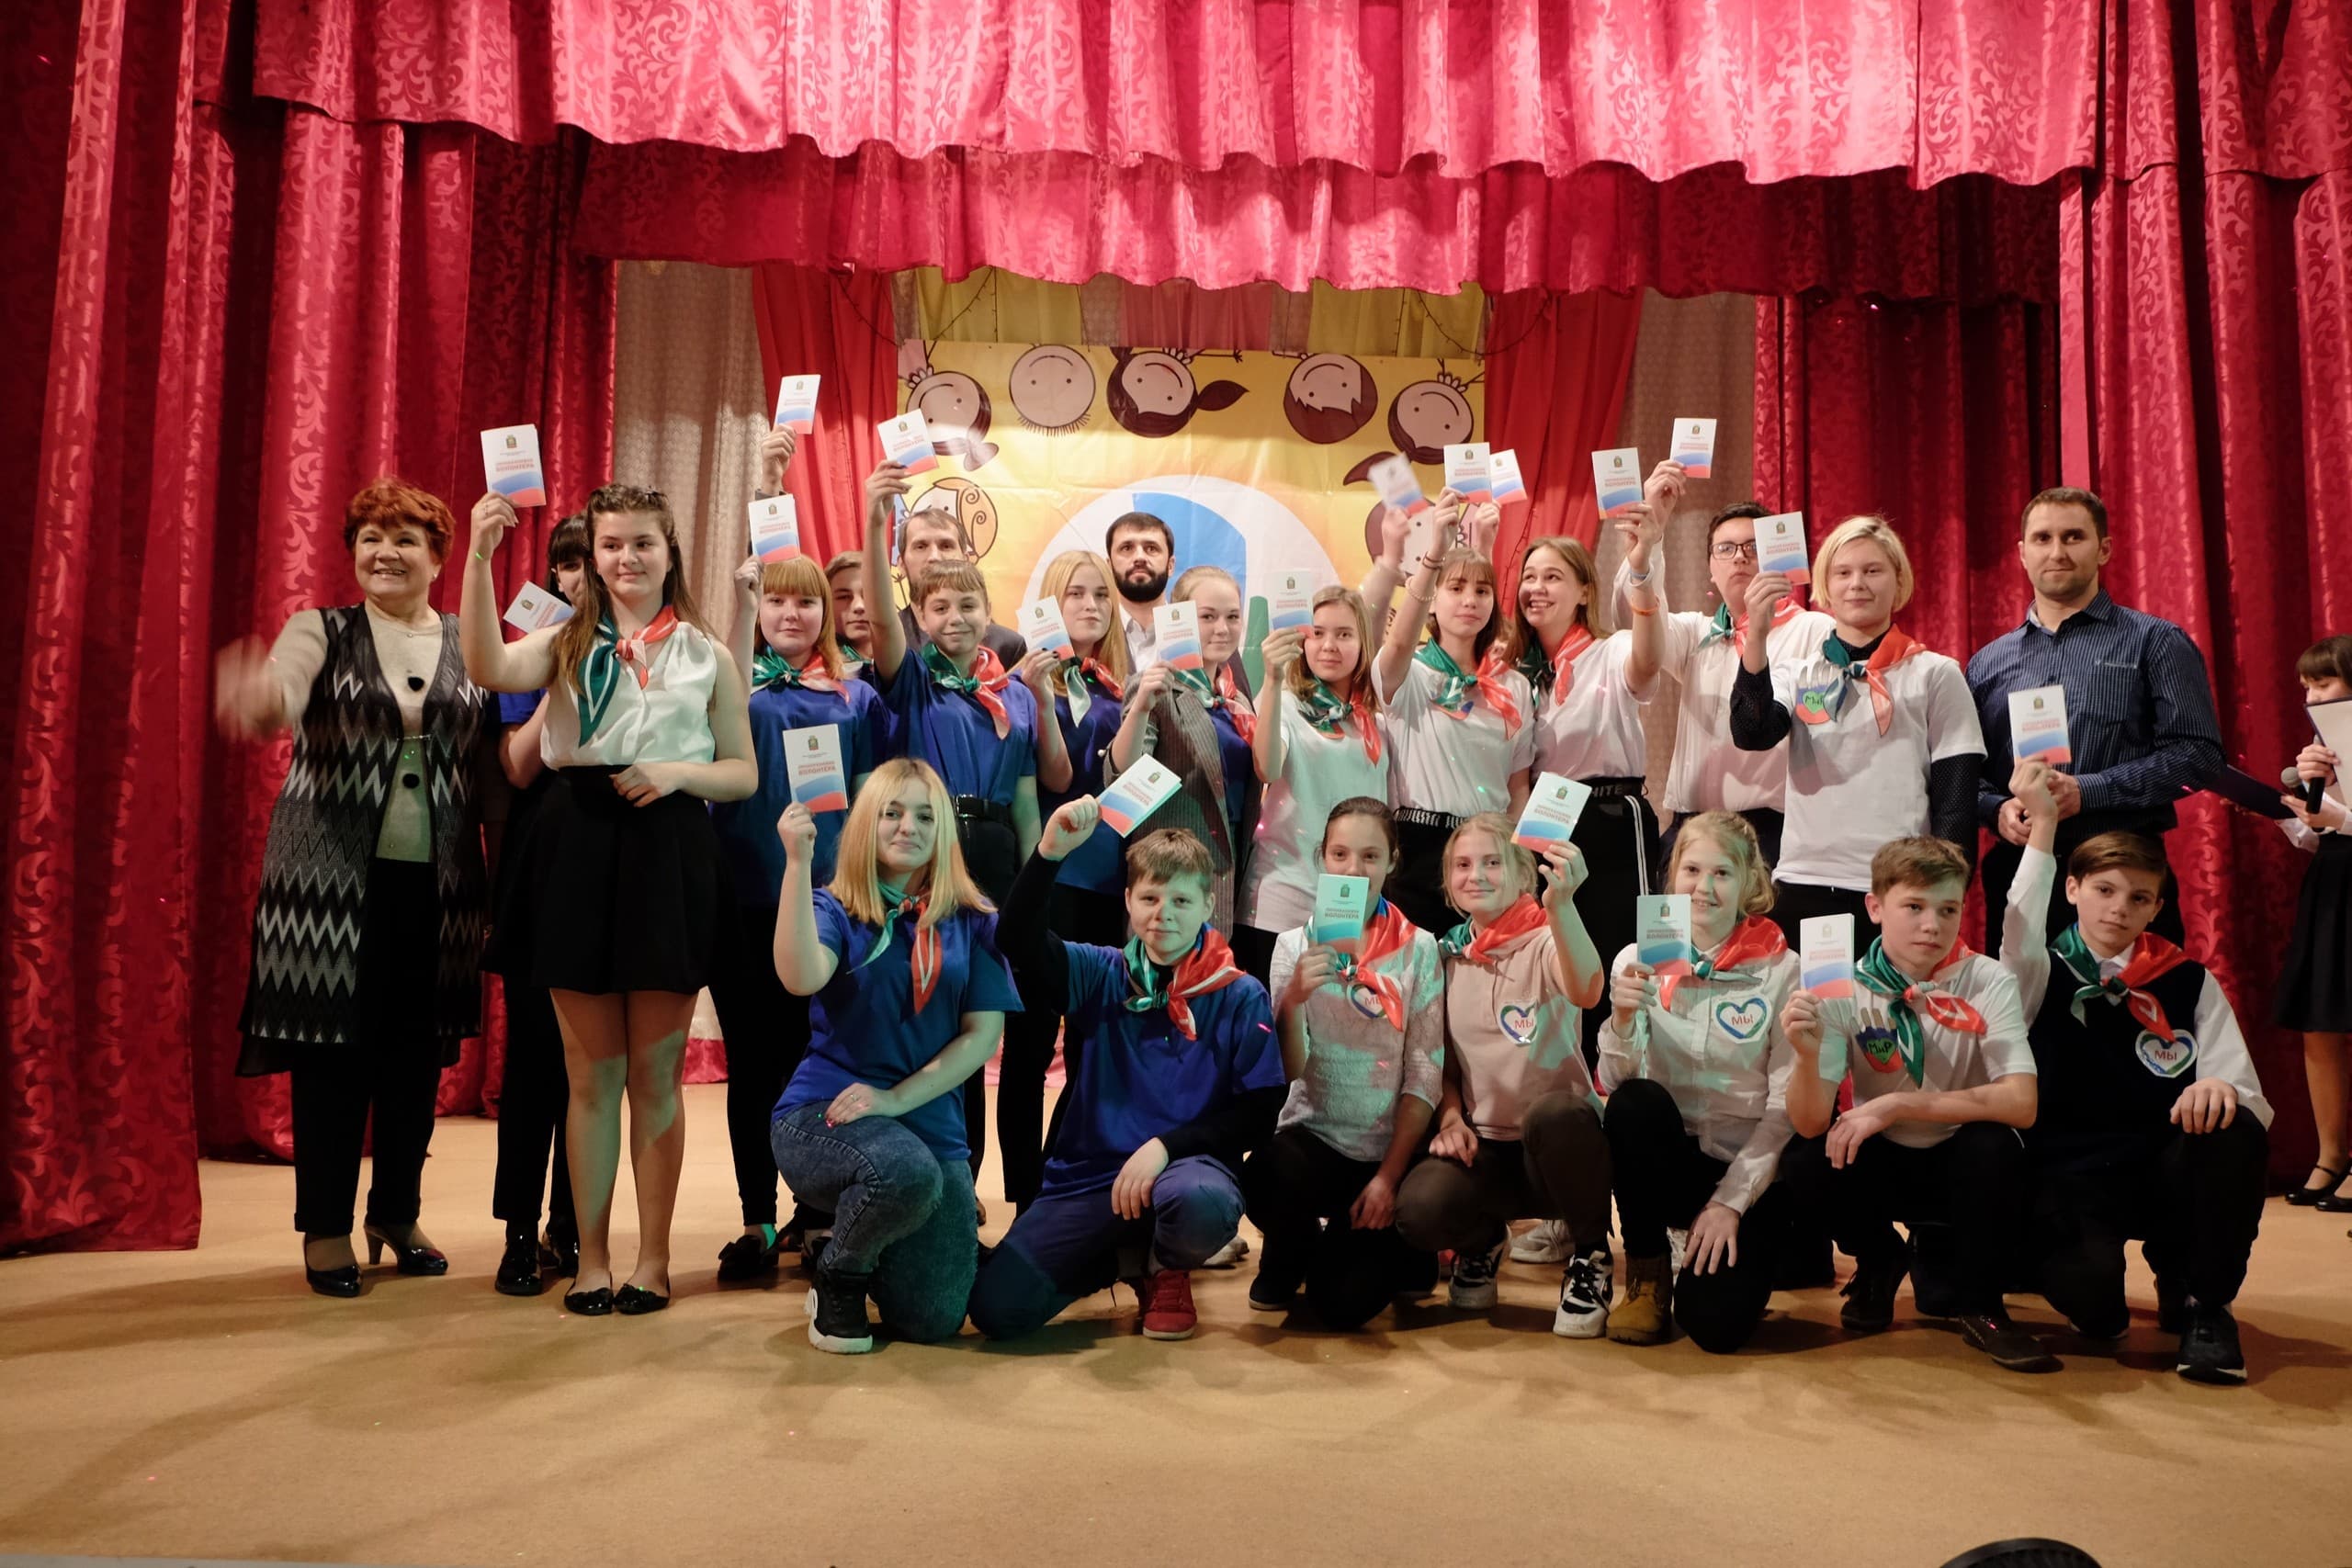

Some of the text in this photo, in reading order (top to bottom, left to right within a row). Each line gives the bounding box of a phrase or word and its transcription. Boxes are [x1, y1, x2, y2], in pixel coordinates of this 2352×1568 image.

[1515, 1018, 1534, 1029] МЫ
[1732, 1014, 1753, 1025] МЫ
[2154, 1050, 2177, 1060] МЫ
